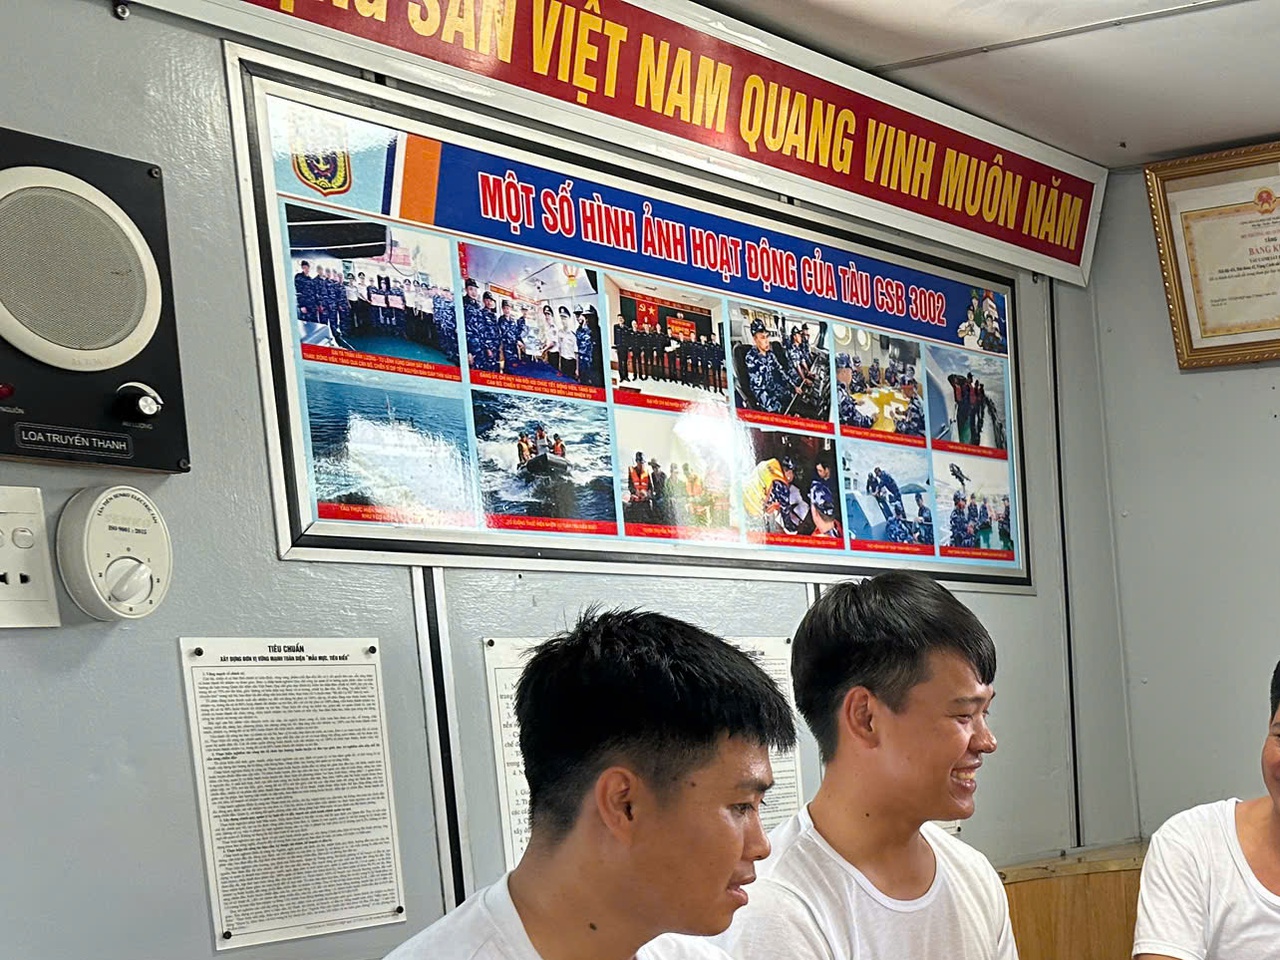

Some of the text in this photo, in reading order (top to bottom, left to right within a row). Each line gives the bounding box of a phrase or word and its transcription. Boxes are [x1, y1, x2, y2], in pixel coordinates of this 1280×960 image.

[532, 0, 628, 104] VIỆT
[635, 33, 732, 133] NAM
[739, 74, 856, 174] QUANG
[864, 118, 936, 200] VINH
[938, 147, 1022, 230] MUÔN
[1022, 176, 1083, 250] NĂM
[478, 170, 947, 327] MỘT SỐ HÌNH ẢNH HOẠT ĐỘNG CỦA TÀU CSB 3002
[22, 430, 45, 441] LOA
[91, 438, 127, 450] THANH
[268, 642, 304, 652] TIÊU CHUẨN
